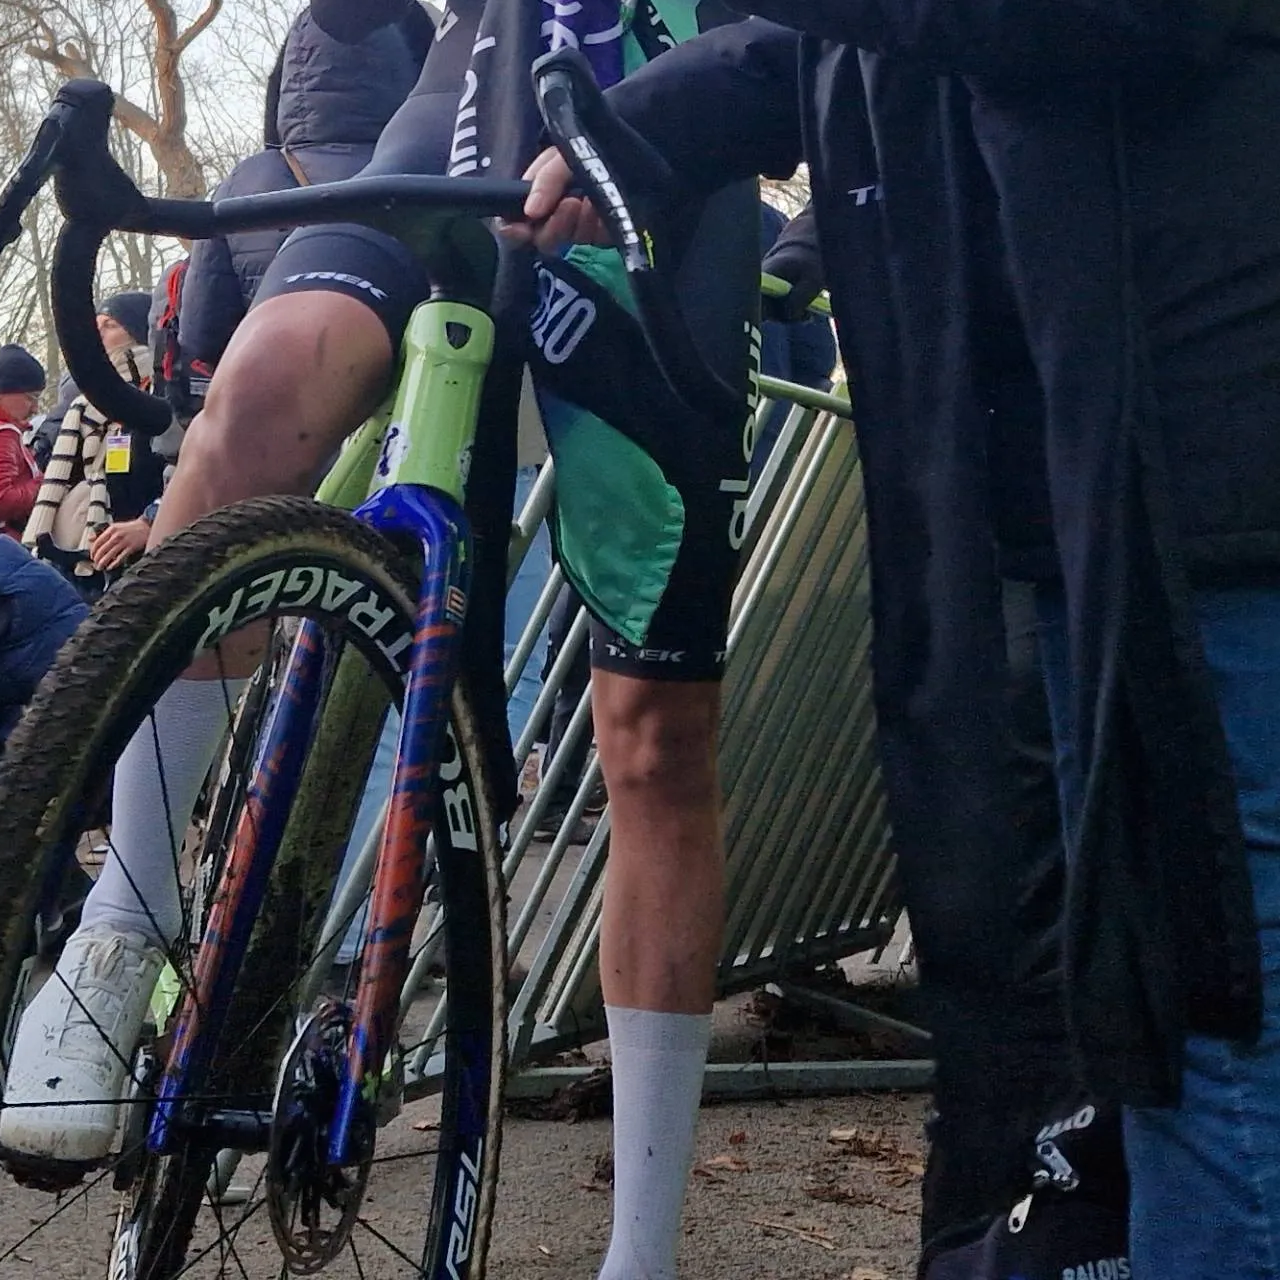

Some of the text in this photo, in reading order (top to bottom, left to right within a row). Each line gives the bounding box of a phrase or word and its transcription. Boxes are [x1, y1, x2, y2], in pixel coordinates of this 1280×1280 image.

[569, 135, 640, 245] SRAM
[282, 271, 389, 301] TREK
[445, 1137, 483, 1280] RSL
[1062, 1256, 1131, 1280] BALOIS
